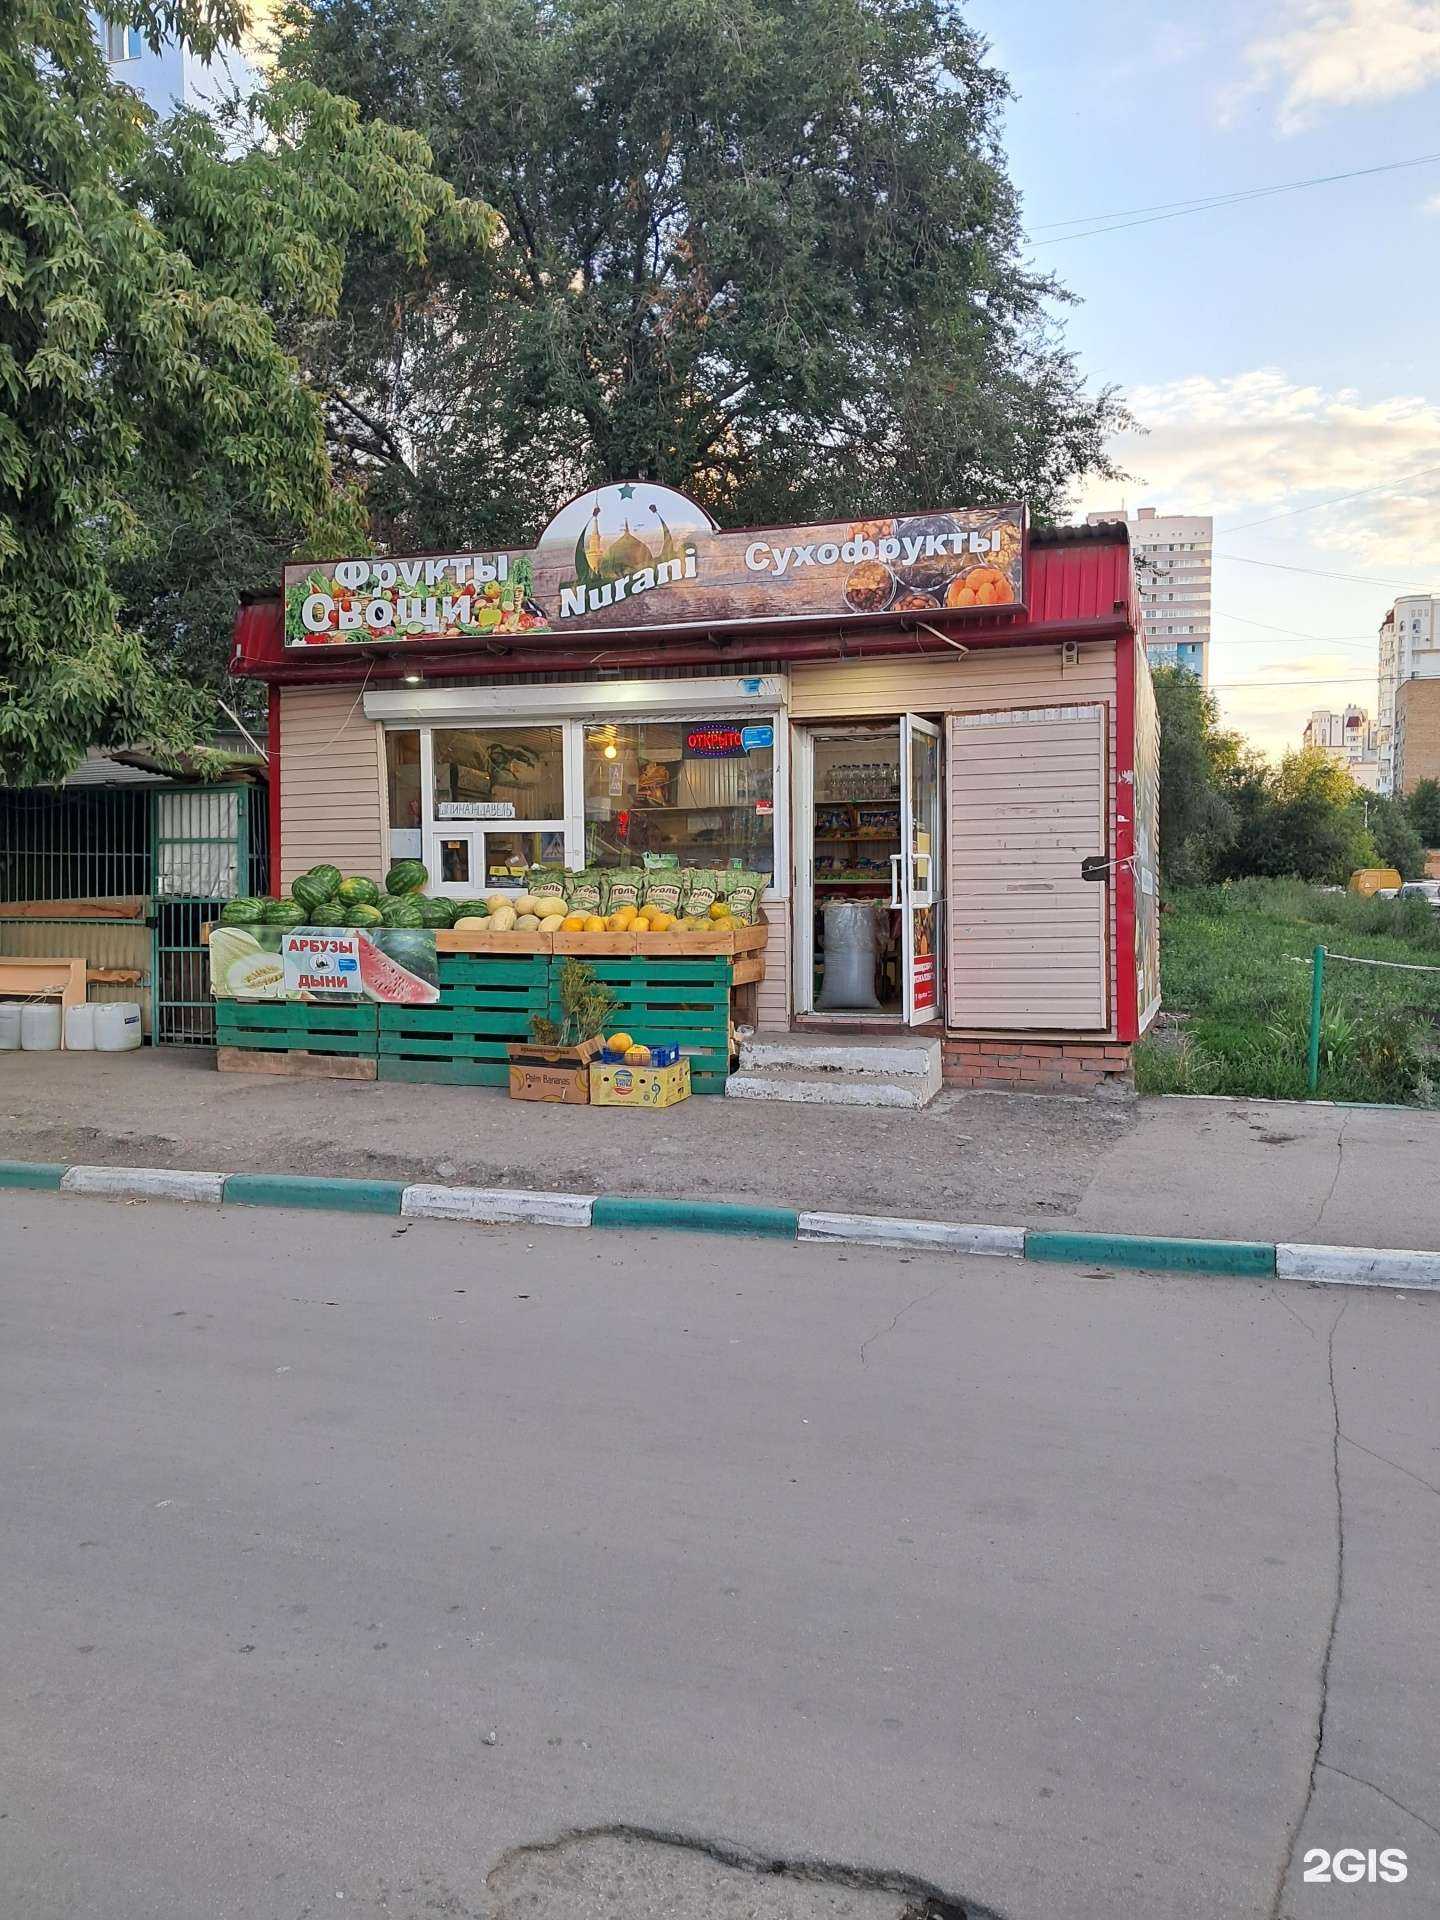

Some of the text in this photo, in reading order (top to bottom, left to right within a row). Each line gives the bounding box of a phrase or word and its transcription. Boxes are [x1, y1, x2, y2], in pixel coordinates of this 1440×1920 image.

[745, 530, 1001, 576] Сухофрукты
[334, 554, 508, 599] Фрукты
[560, 547, 697, 618] Nurani
[302, 592, 472, 632] Овощи
[288, 939, 353, 954] АРБУЗЫ
[298, 974, 348, 989] ДЫНИ
